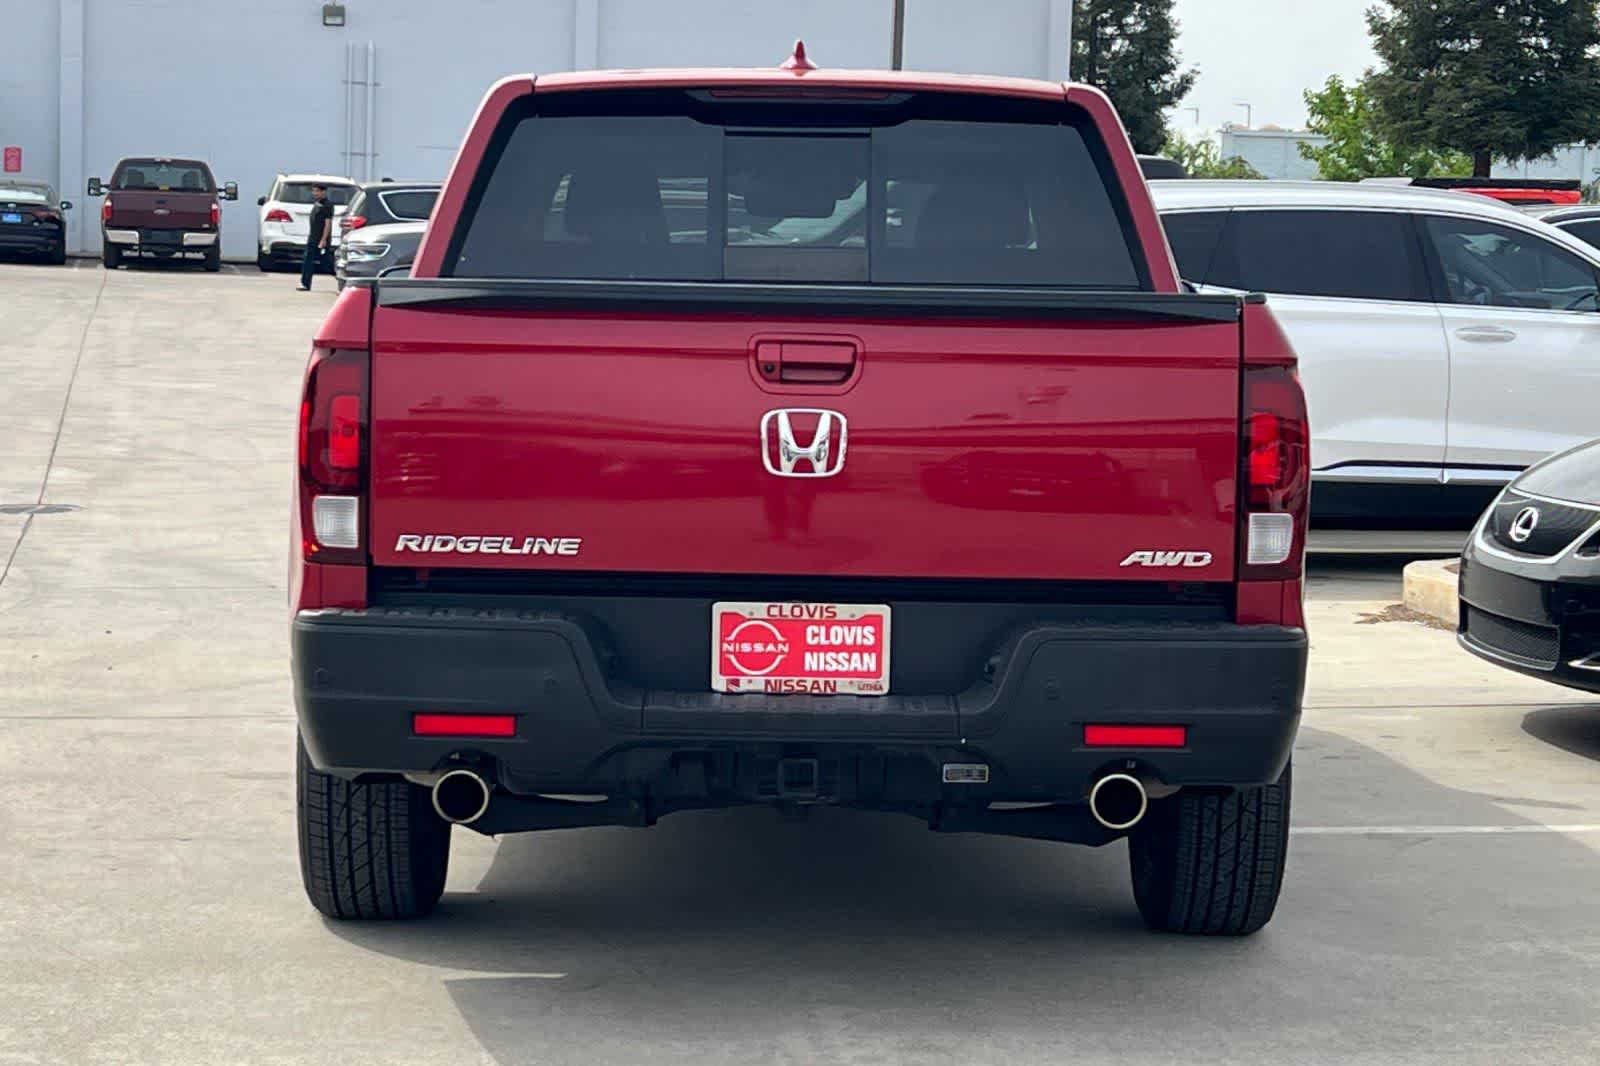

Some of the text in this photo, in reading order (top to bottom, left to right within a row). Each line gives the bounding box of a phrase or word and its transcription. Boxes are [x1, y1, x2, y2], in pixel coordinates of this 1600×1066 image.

[395, 533, 582, 555] RIDGELINE
[1119, 550, 1212, 567] AWD
[766, 604, 838, 619] CLOVIS
[806, 624, 875, 646] CLOVIS
[722, 642, 789, 653] NISSAN
[804, 651, 876, 672] NISSAN
[764, 679, 837, 693] NISSAN
